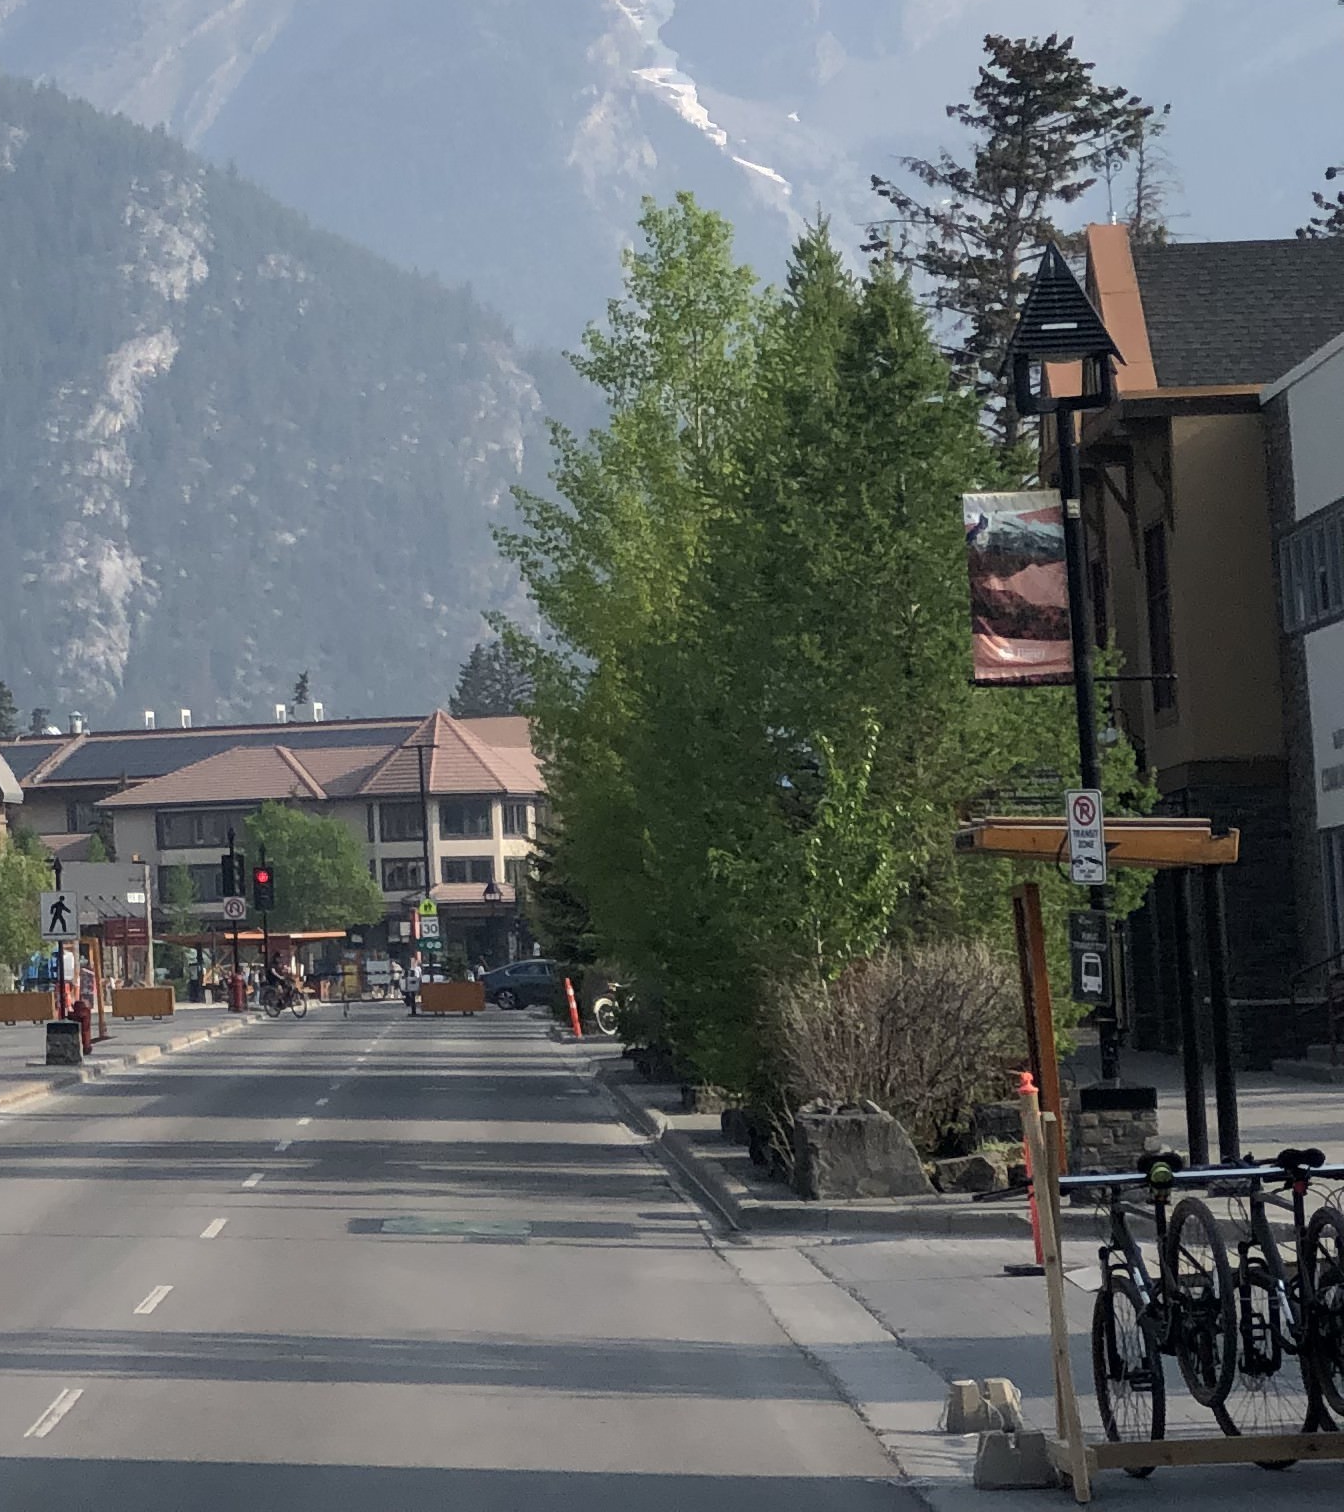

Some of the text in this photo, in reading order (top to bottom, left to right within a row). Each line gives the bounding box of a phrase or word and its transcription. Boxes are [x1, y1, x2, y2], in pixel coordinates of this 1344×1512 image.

[1072, 829, 1099, 838] TRANSIT
[1078, 840, 1095, 849] ZONE
[423, 923, 438, 934] 30
